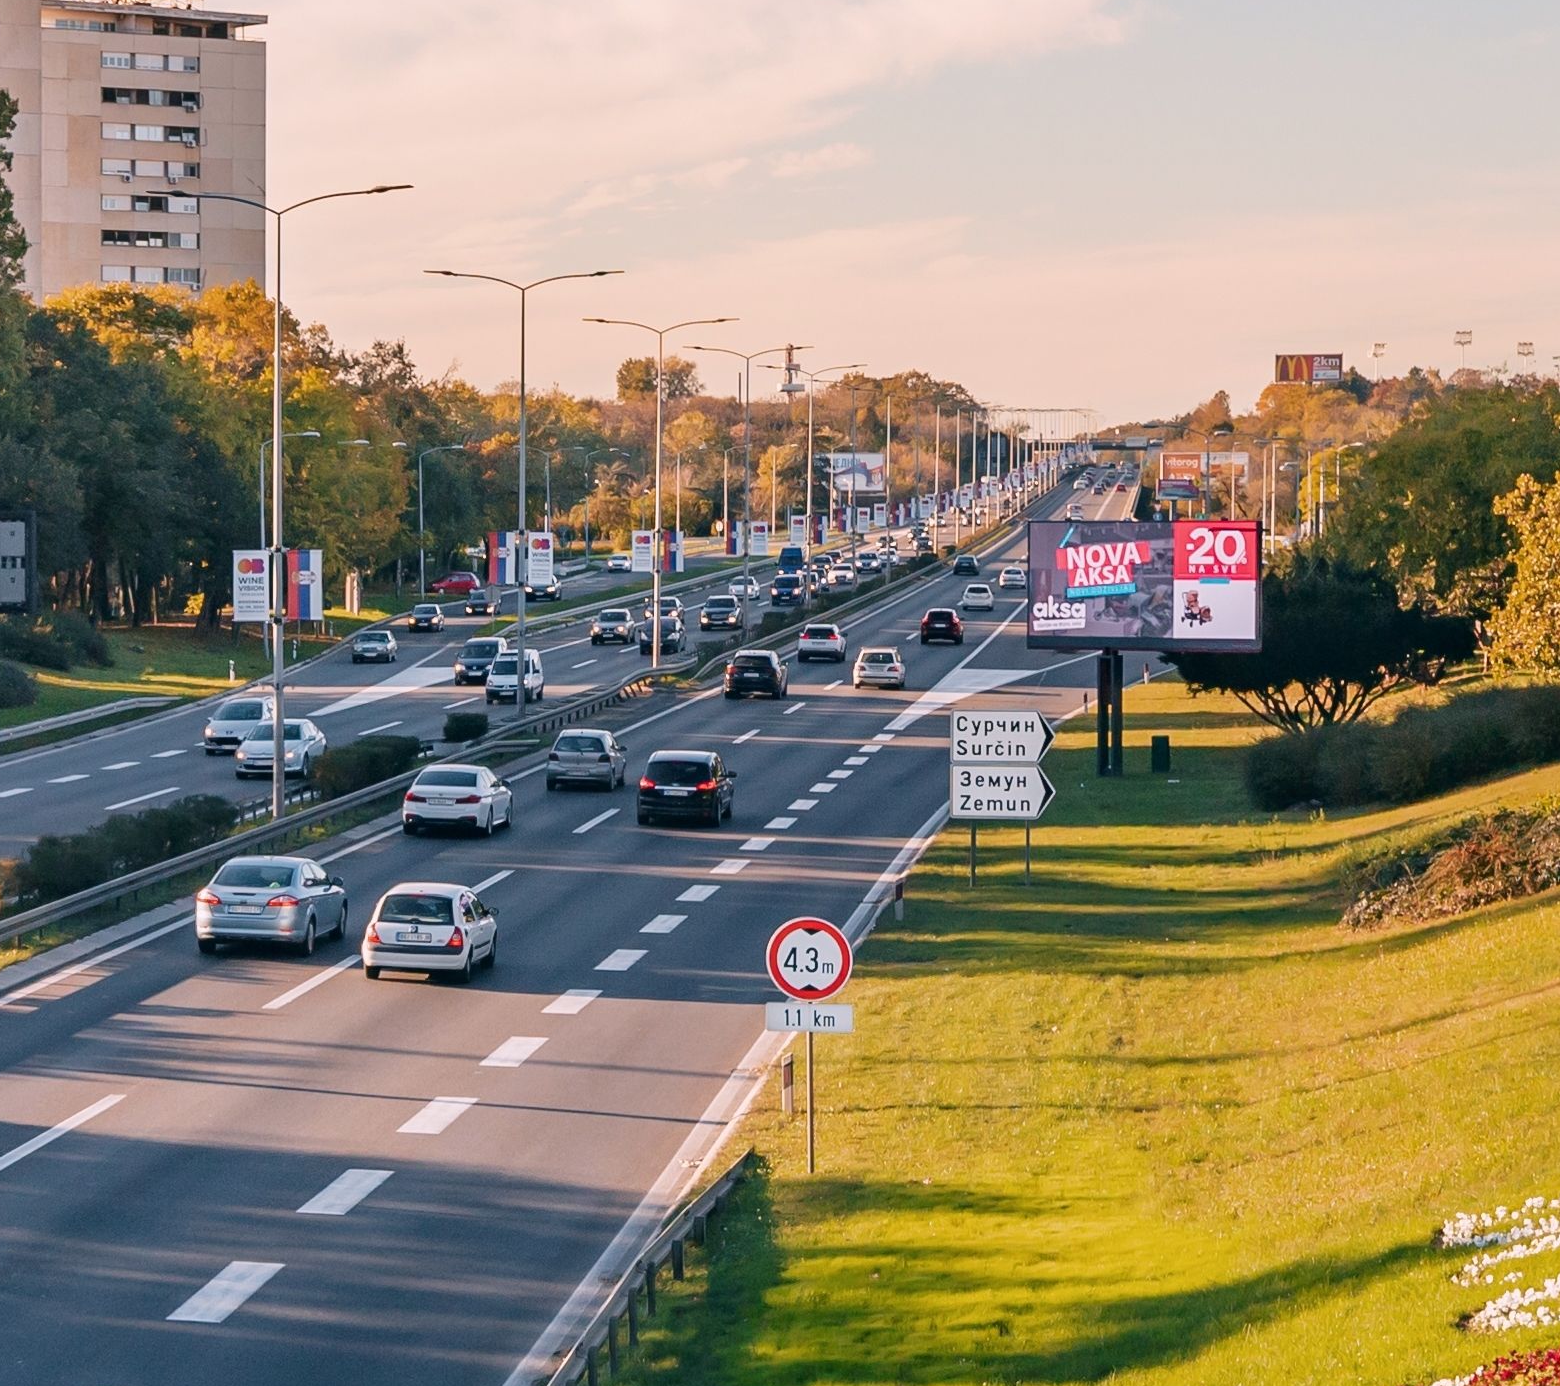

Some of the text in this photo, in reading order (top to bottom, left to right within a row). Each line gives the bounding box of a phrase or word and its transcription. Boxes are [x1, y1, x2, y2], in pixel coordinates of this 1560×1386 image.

[1165, 457, 1199, 469] vitorog
[1066, 541, 1142, 570] NOVA
[1073, 565, 1131, 587] AKSA
[1188, 564, 1238, 574] NA SVE
[238, 576, 265, 585] WINE
[1032, 594, 1086, 619] aksa
[956, 716, 1035, 736] Сурчин
[956, 739, 1026, 757] Surčin
[960, 771, 1027, 792] Земун
[960, 795, 1031, 812] Zemun
[783, 946, 834, 974] 4.3 m
[784, 1008, 835, 1027] 1.1 km
